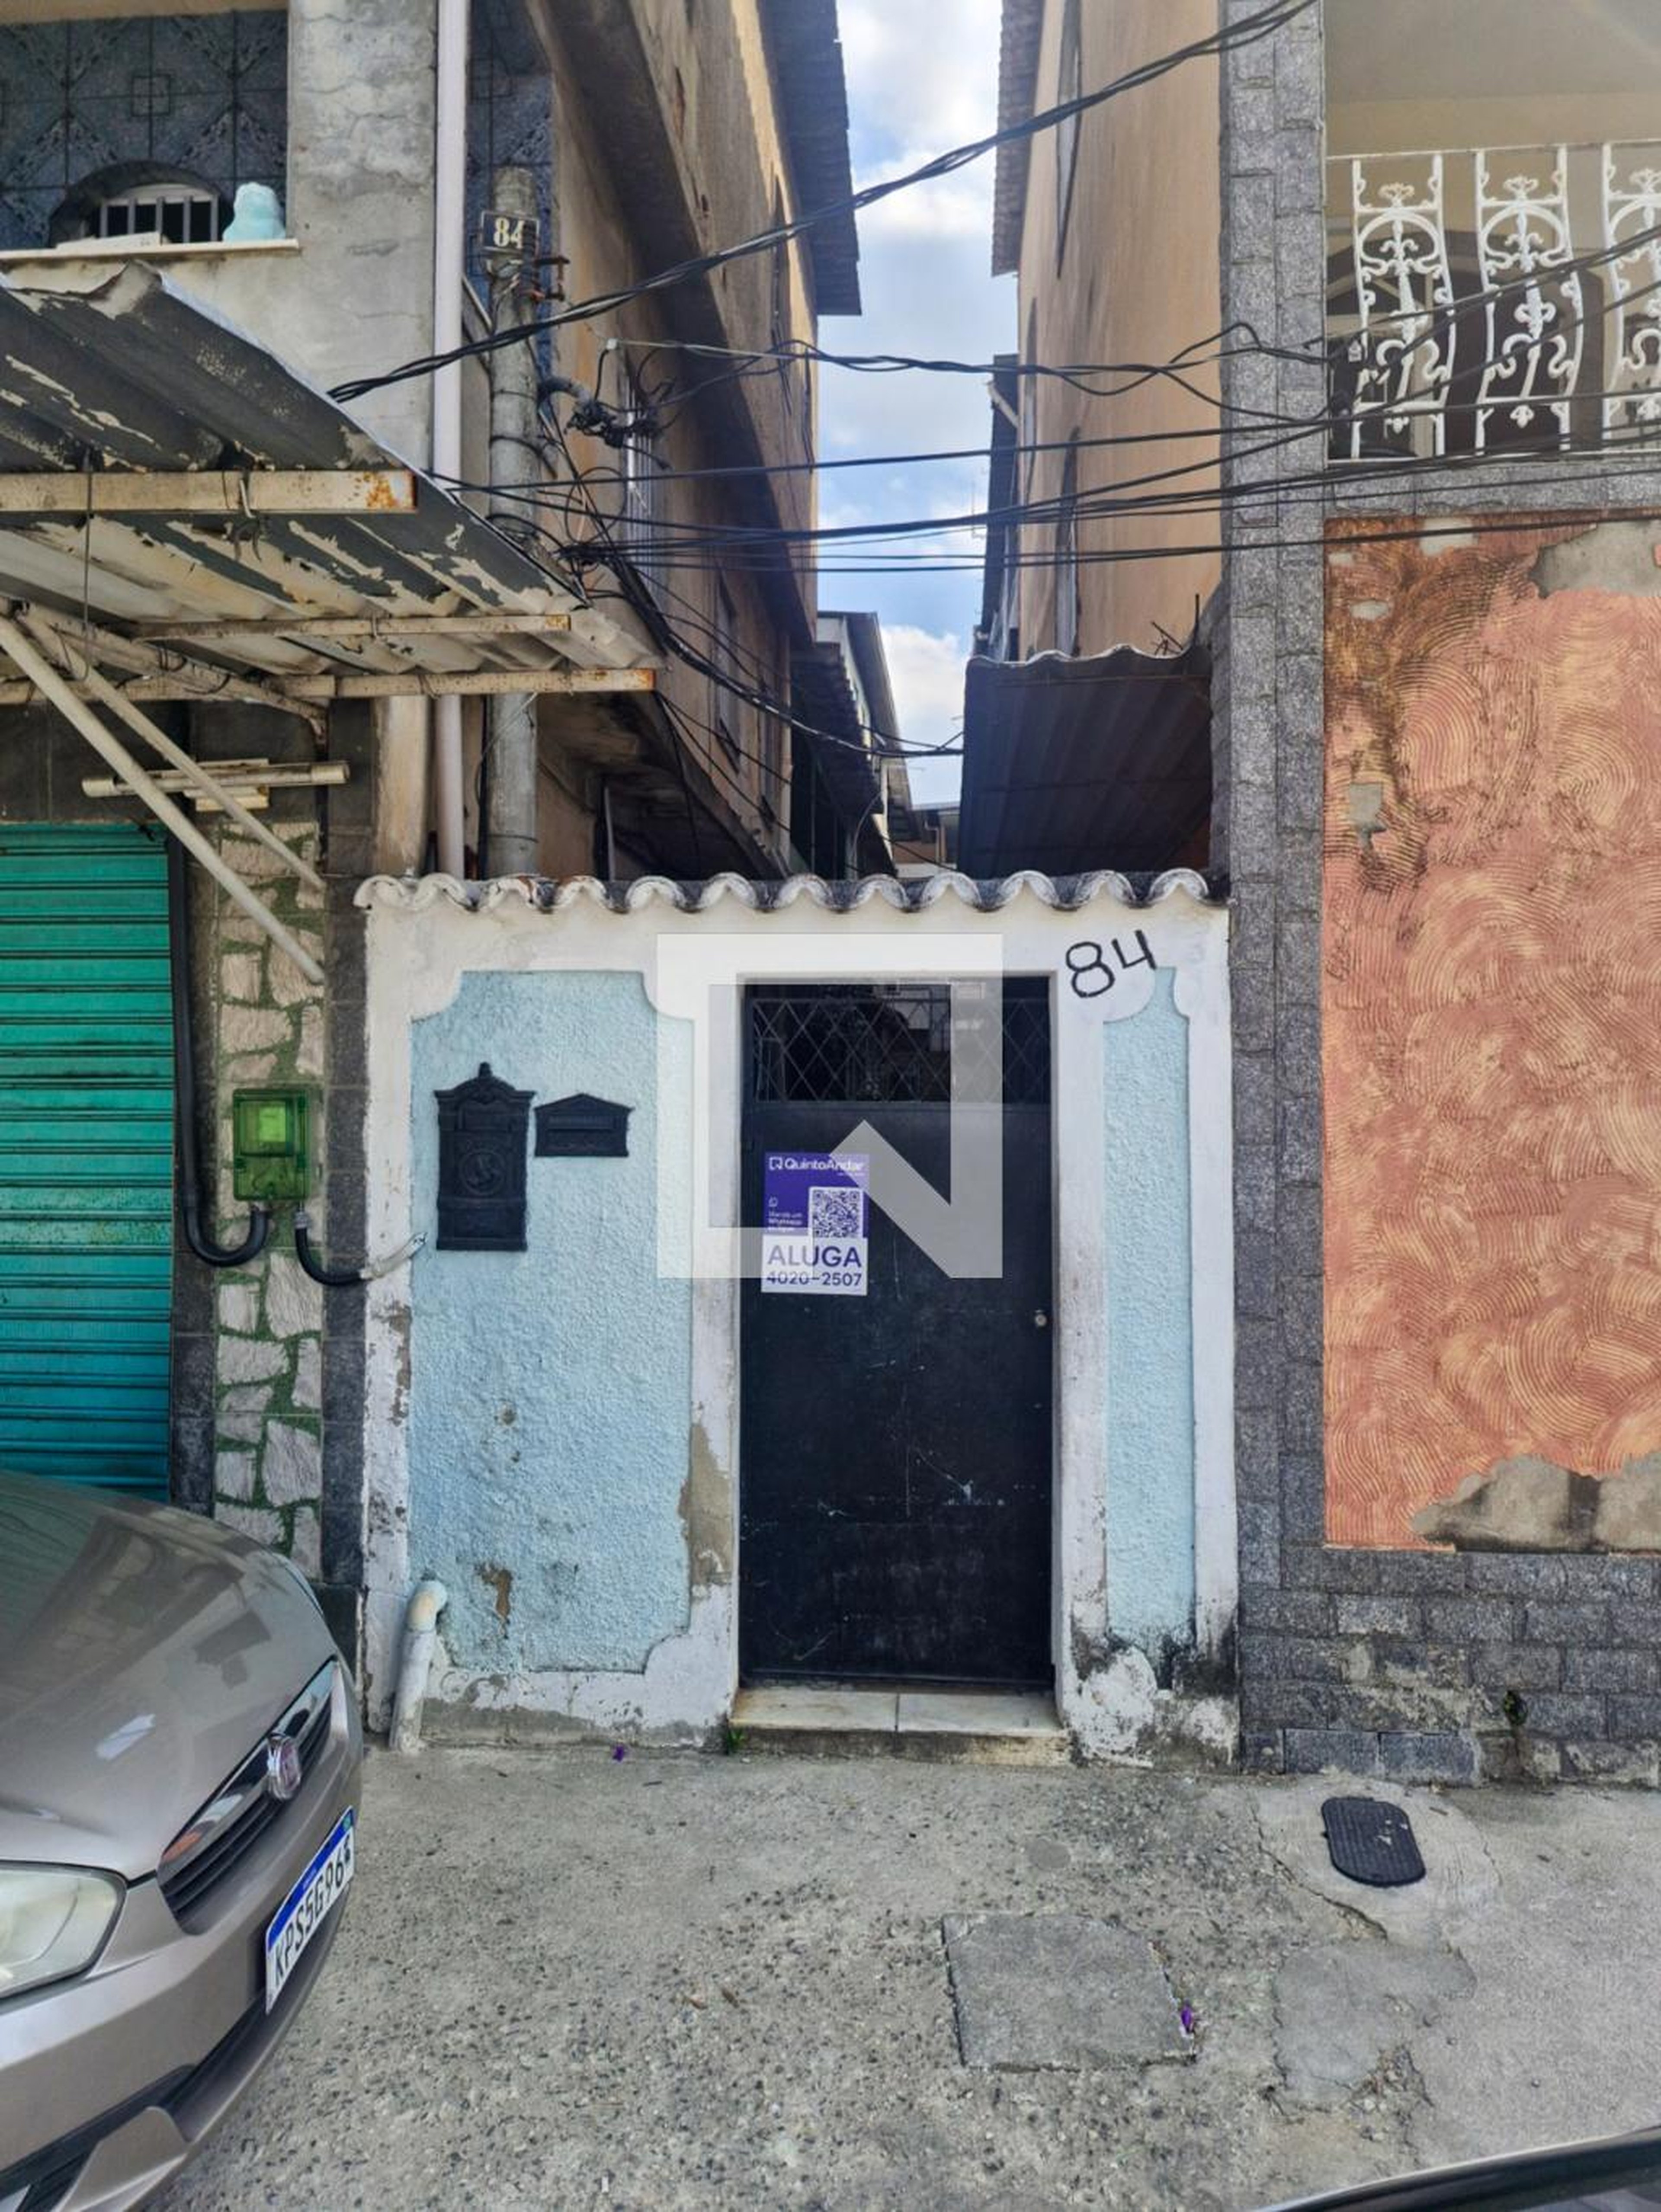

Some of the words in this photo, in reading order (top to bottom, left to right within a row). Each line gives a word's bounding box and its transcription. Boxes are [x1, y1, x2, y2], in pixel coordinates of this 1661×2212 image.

[493, 217, 525, 249] 84
[1065, 929, 1157, 998] 84
[767, 1245, 862, 1268] ALUGA
[766, 1271, 862, 1287] 4020-2507
